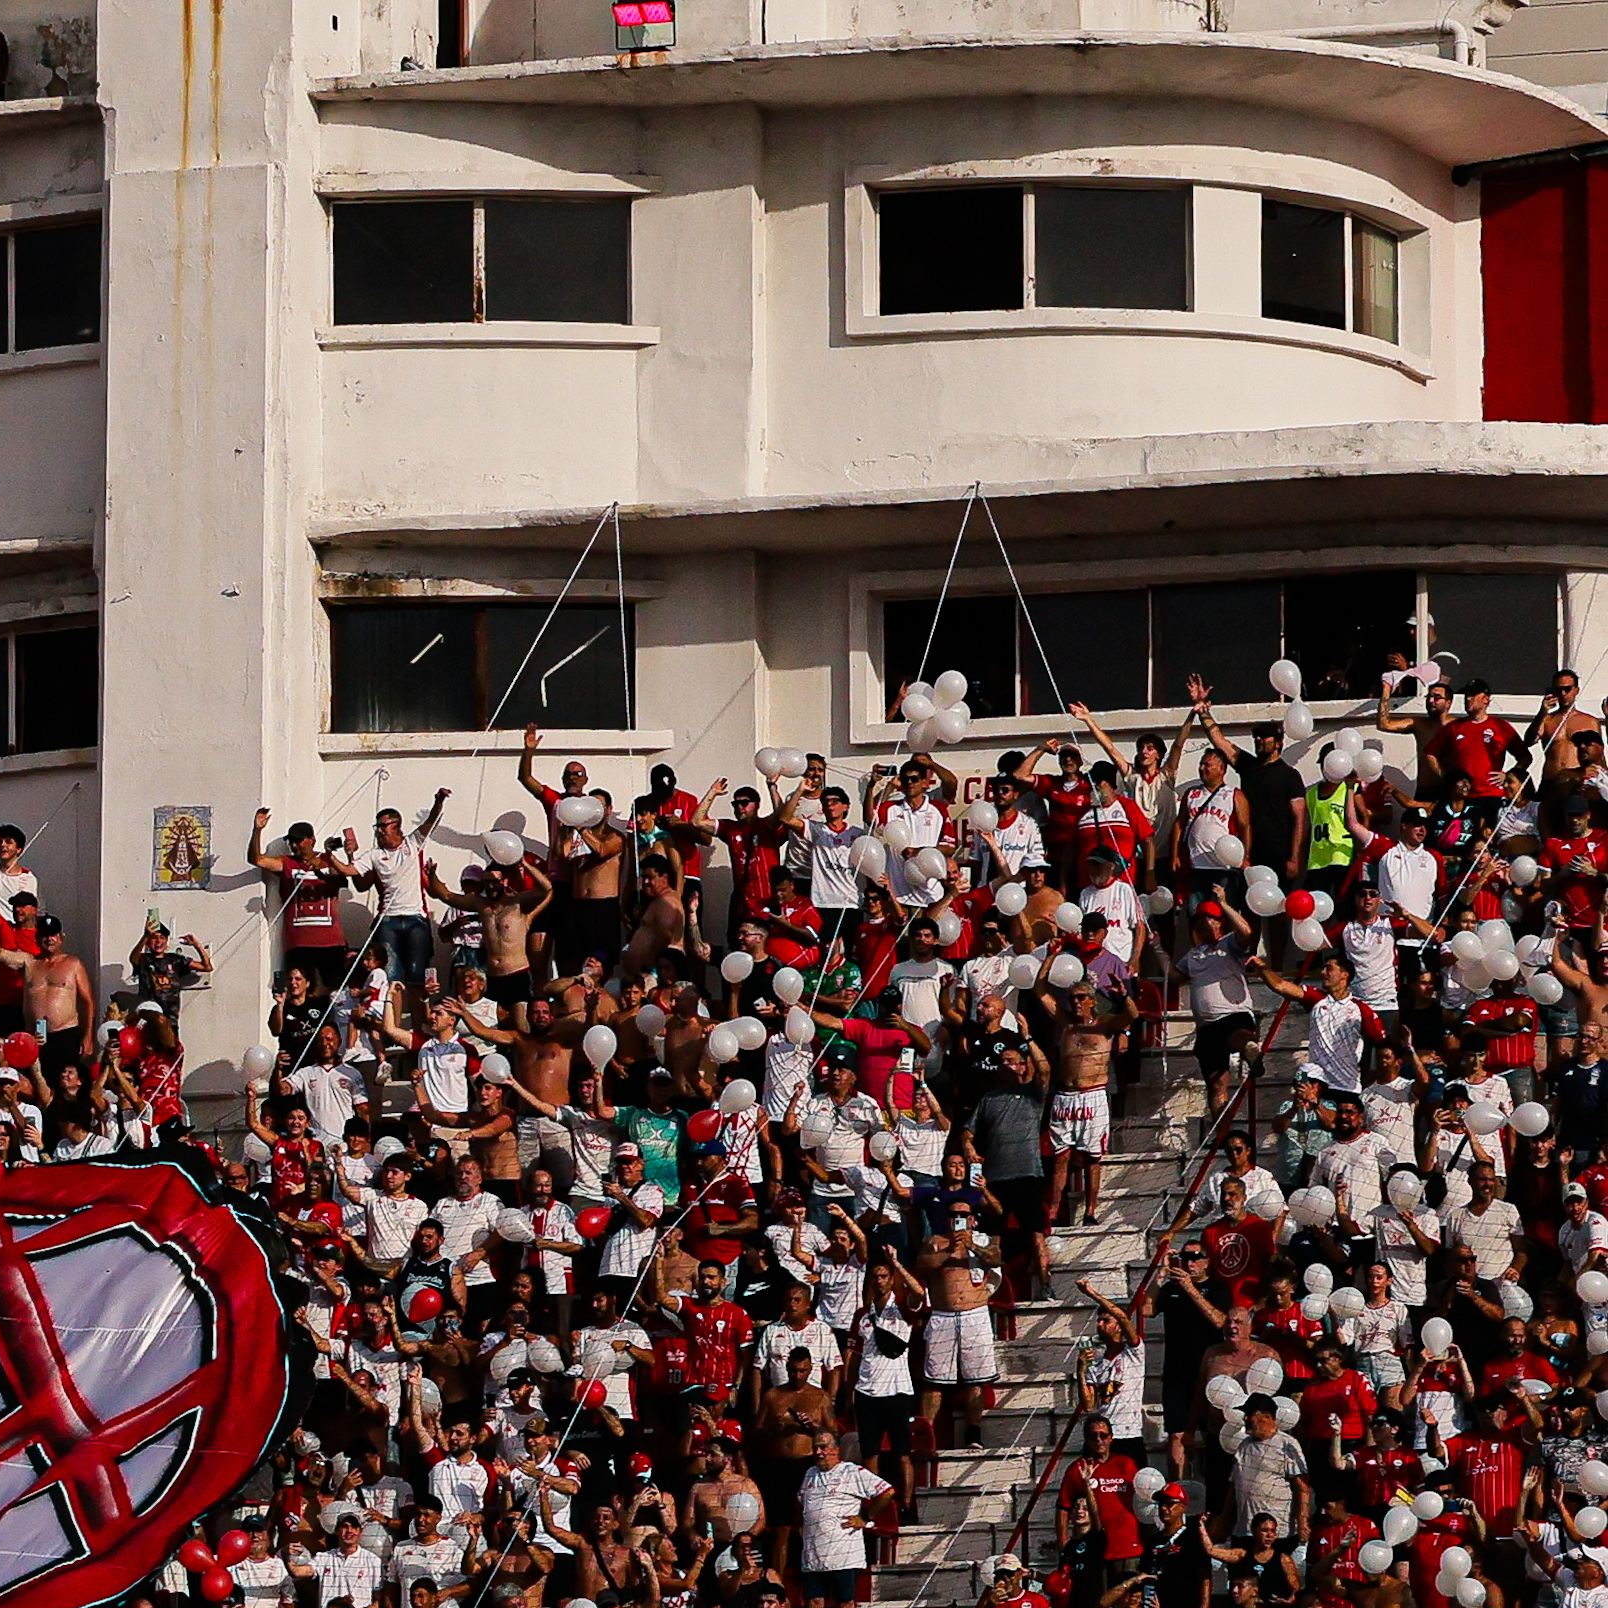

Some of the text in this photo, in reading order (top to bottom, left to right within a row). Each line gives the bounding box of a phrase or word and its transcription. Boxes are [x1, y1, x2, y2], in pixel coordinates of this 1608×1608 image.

[1315, 824, 1330, 842] 04
[1098, 1477, 1125, 1485] Banco
[1100, 1483, 1126, 1493] Ciudad
